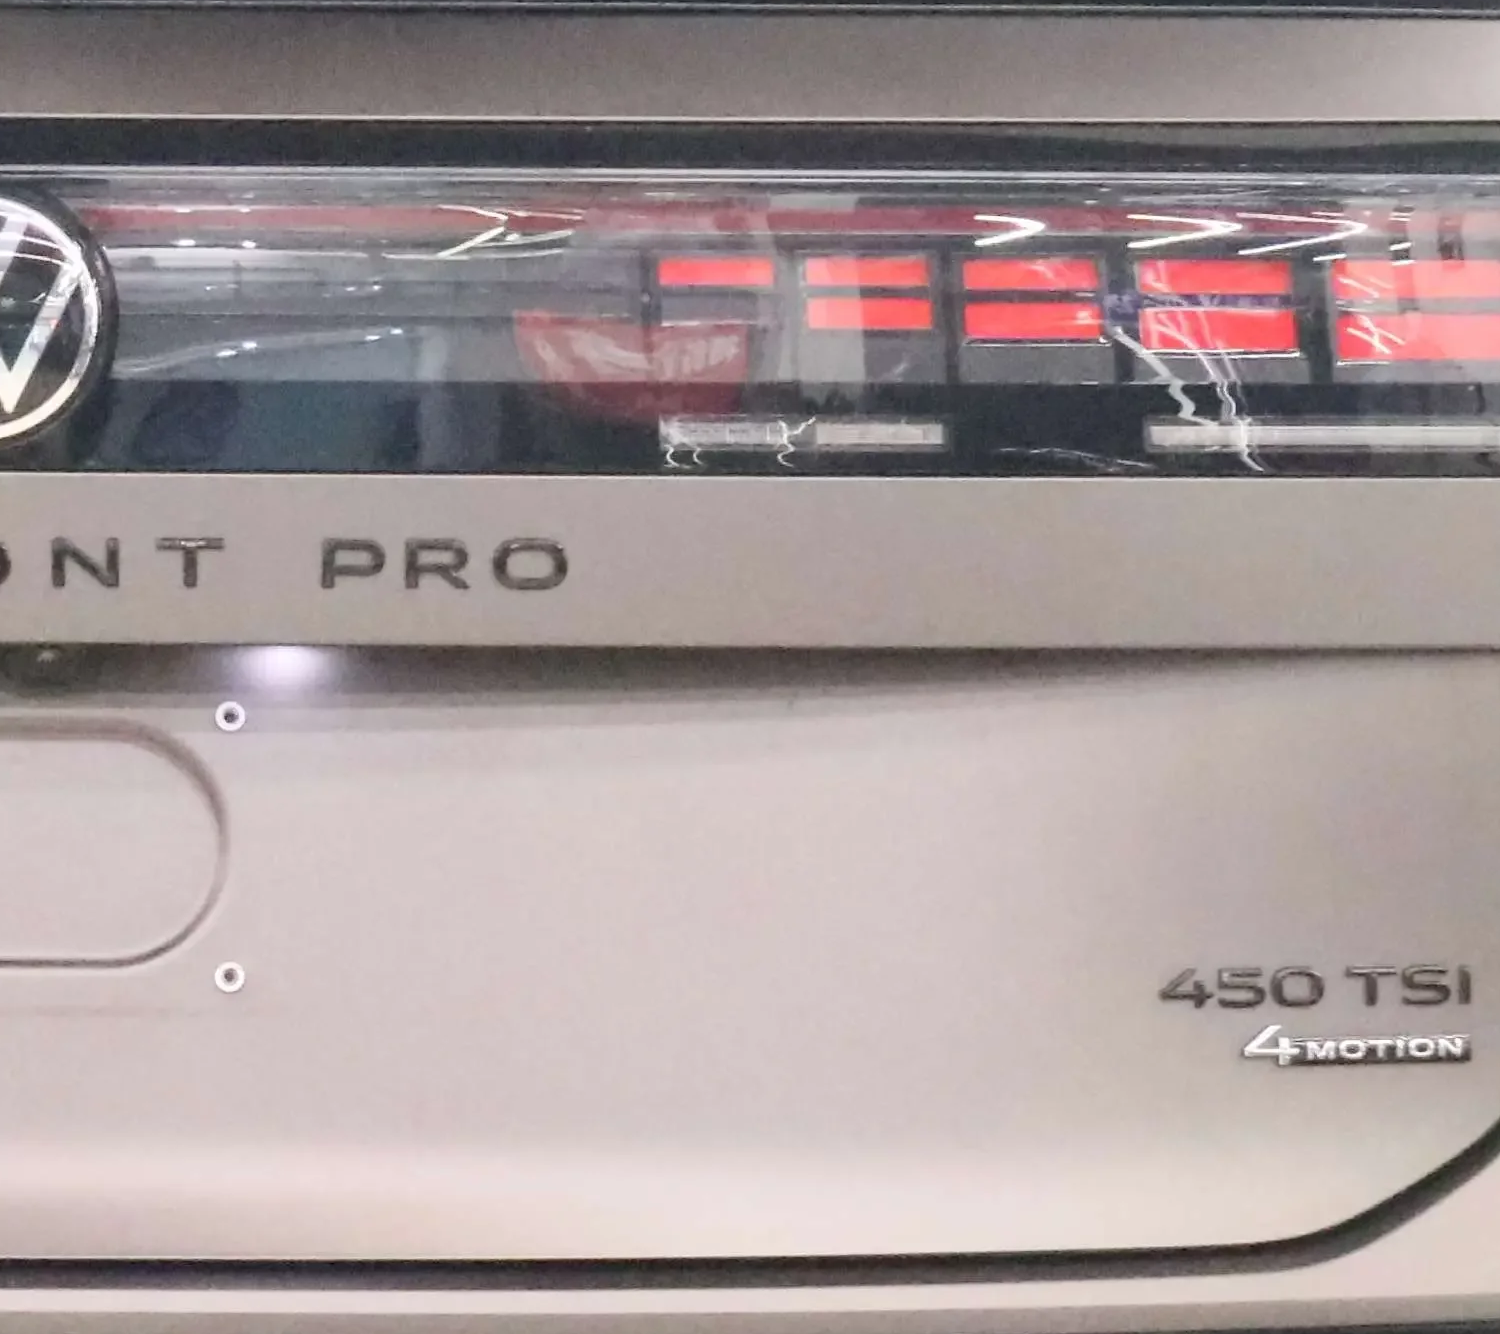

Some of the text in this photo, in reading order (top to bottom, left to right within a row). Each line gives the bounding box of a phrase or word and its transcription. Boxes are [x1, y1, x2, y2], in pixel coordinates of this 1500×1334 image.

[320, 537, 570, 591] PRO
[1158, 964, 1472, 1009] 450 TSI
[1242, 1023, 1472, 1066] 4MOTION
